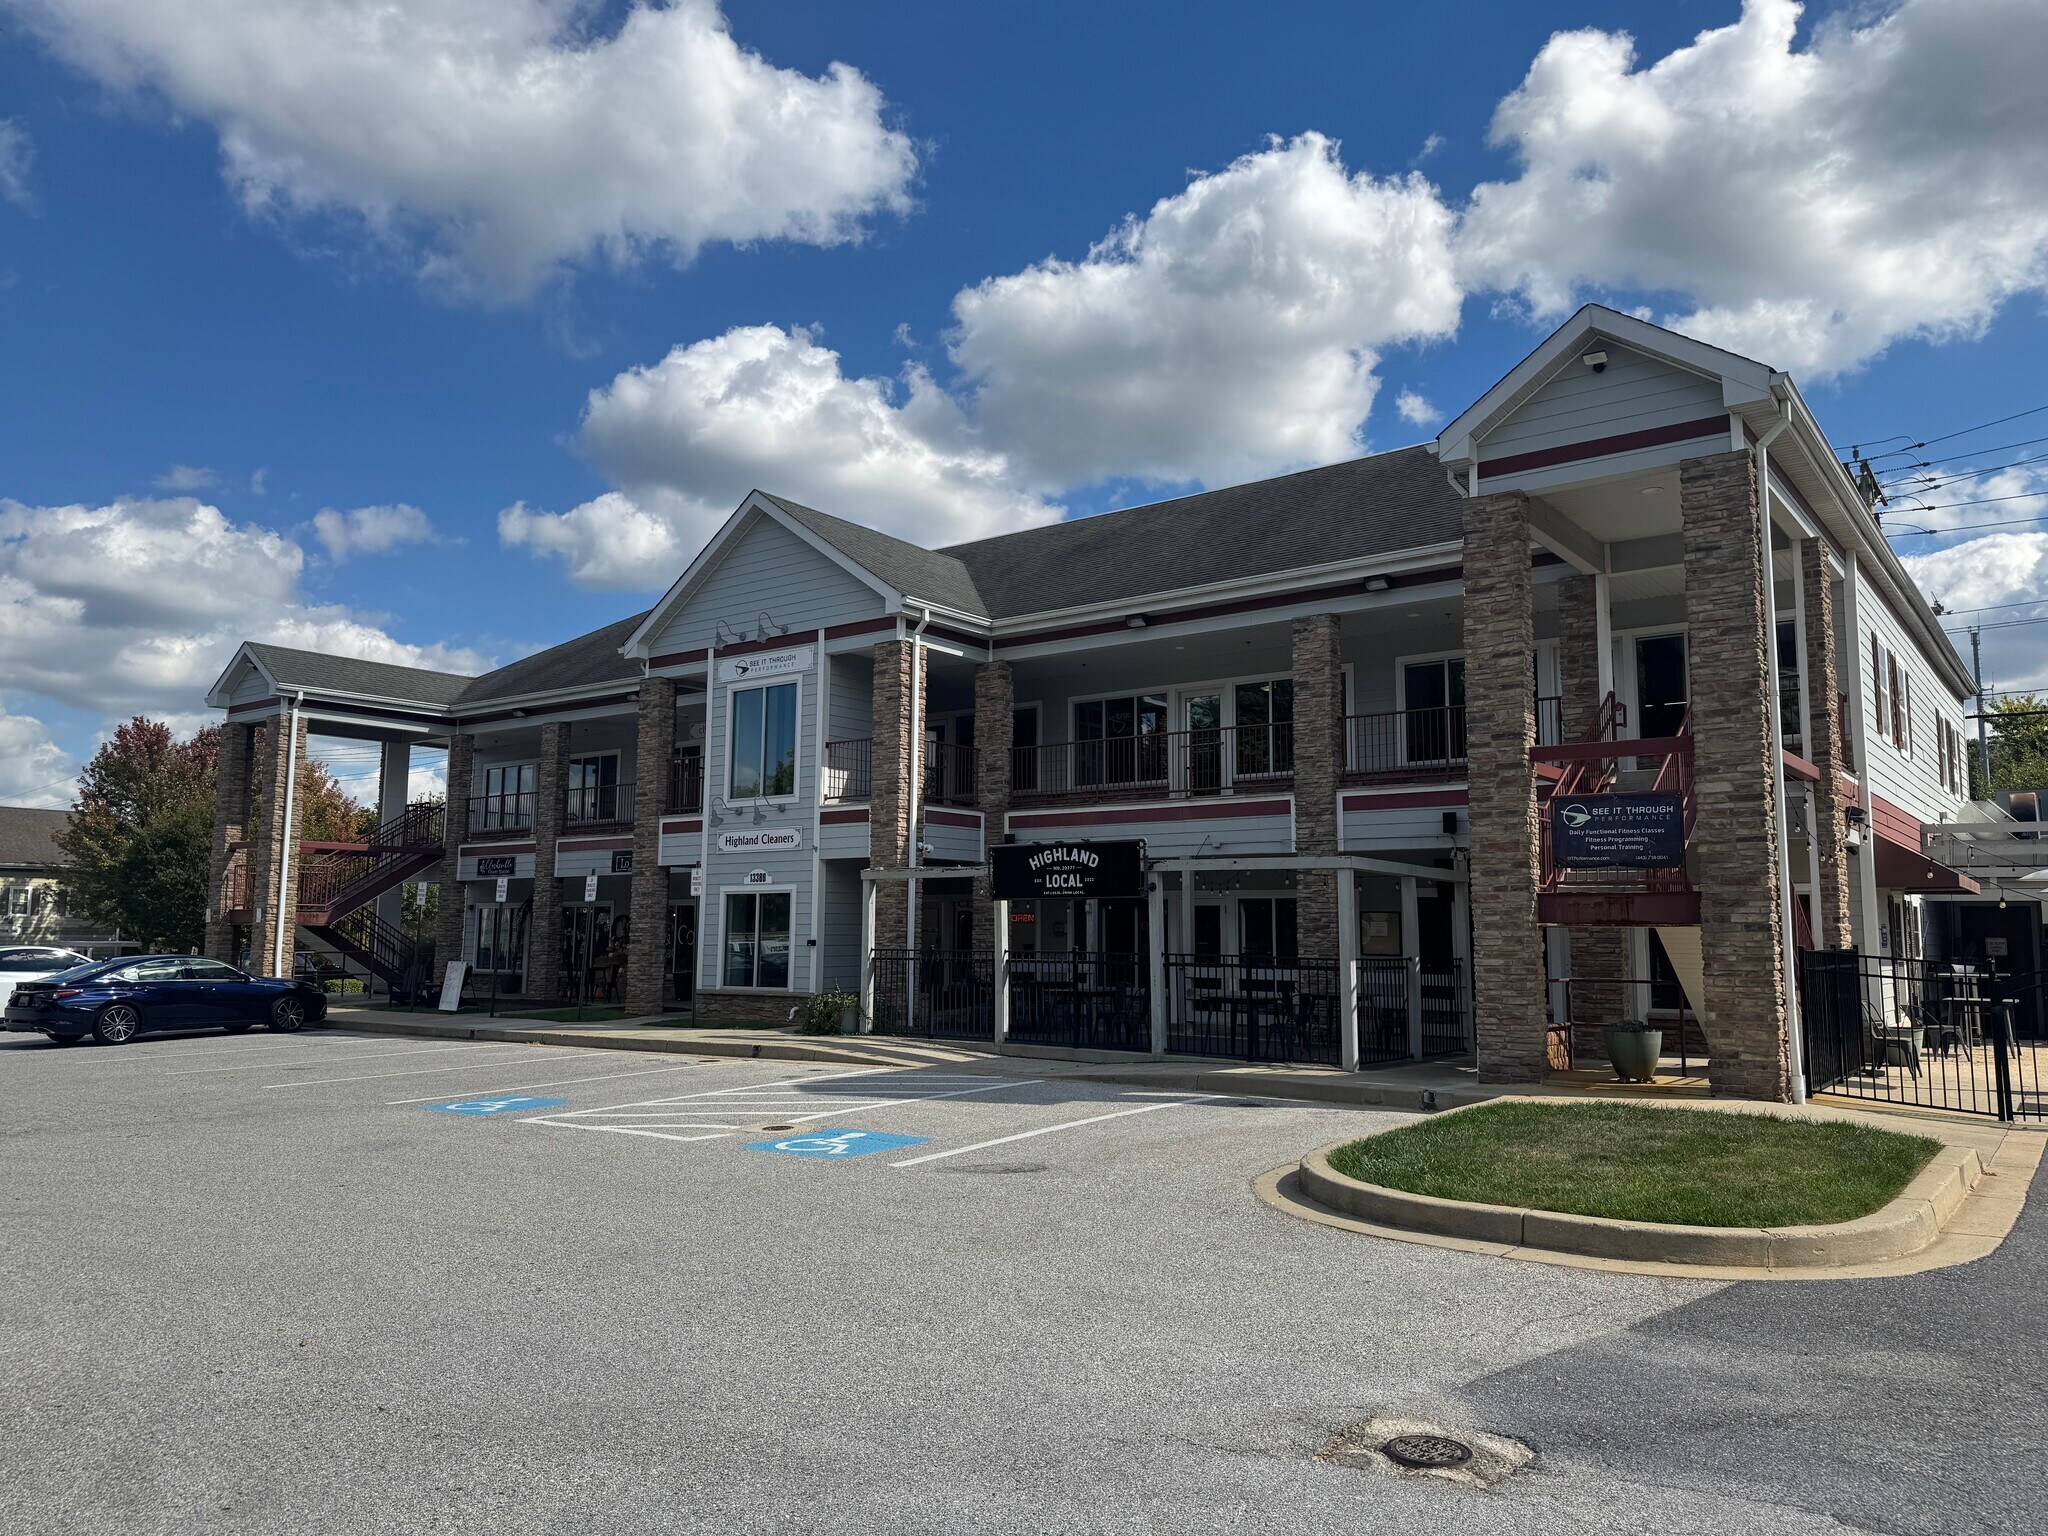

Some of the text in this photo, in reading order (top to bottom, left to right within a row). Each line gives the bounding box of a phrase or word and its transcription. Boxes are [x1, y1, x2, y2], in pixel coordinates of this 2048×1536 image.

[749, 660, 760, 668] SEE
[769, 654, 796, 664] THROUGH
[750, 662, 795, 672] PERFORMANCE
[1592, 805, 1674, 815] SEE IT THROUGH
[1594, 814, 1671, 822] PERFORMANCE
[725, 833, 794, 848] Highland Cleaners
[1028, 847, 1099, 871] HIGHLAND
[1045, 873, 1083, 888] LOCAL
[1011, 914, 1035, 922] OPEN
